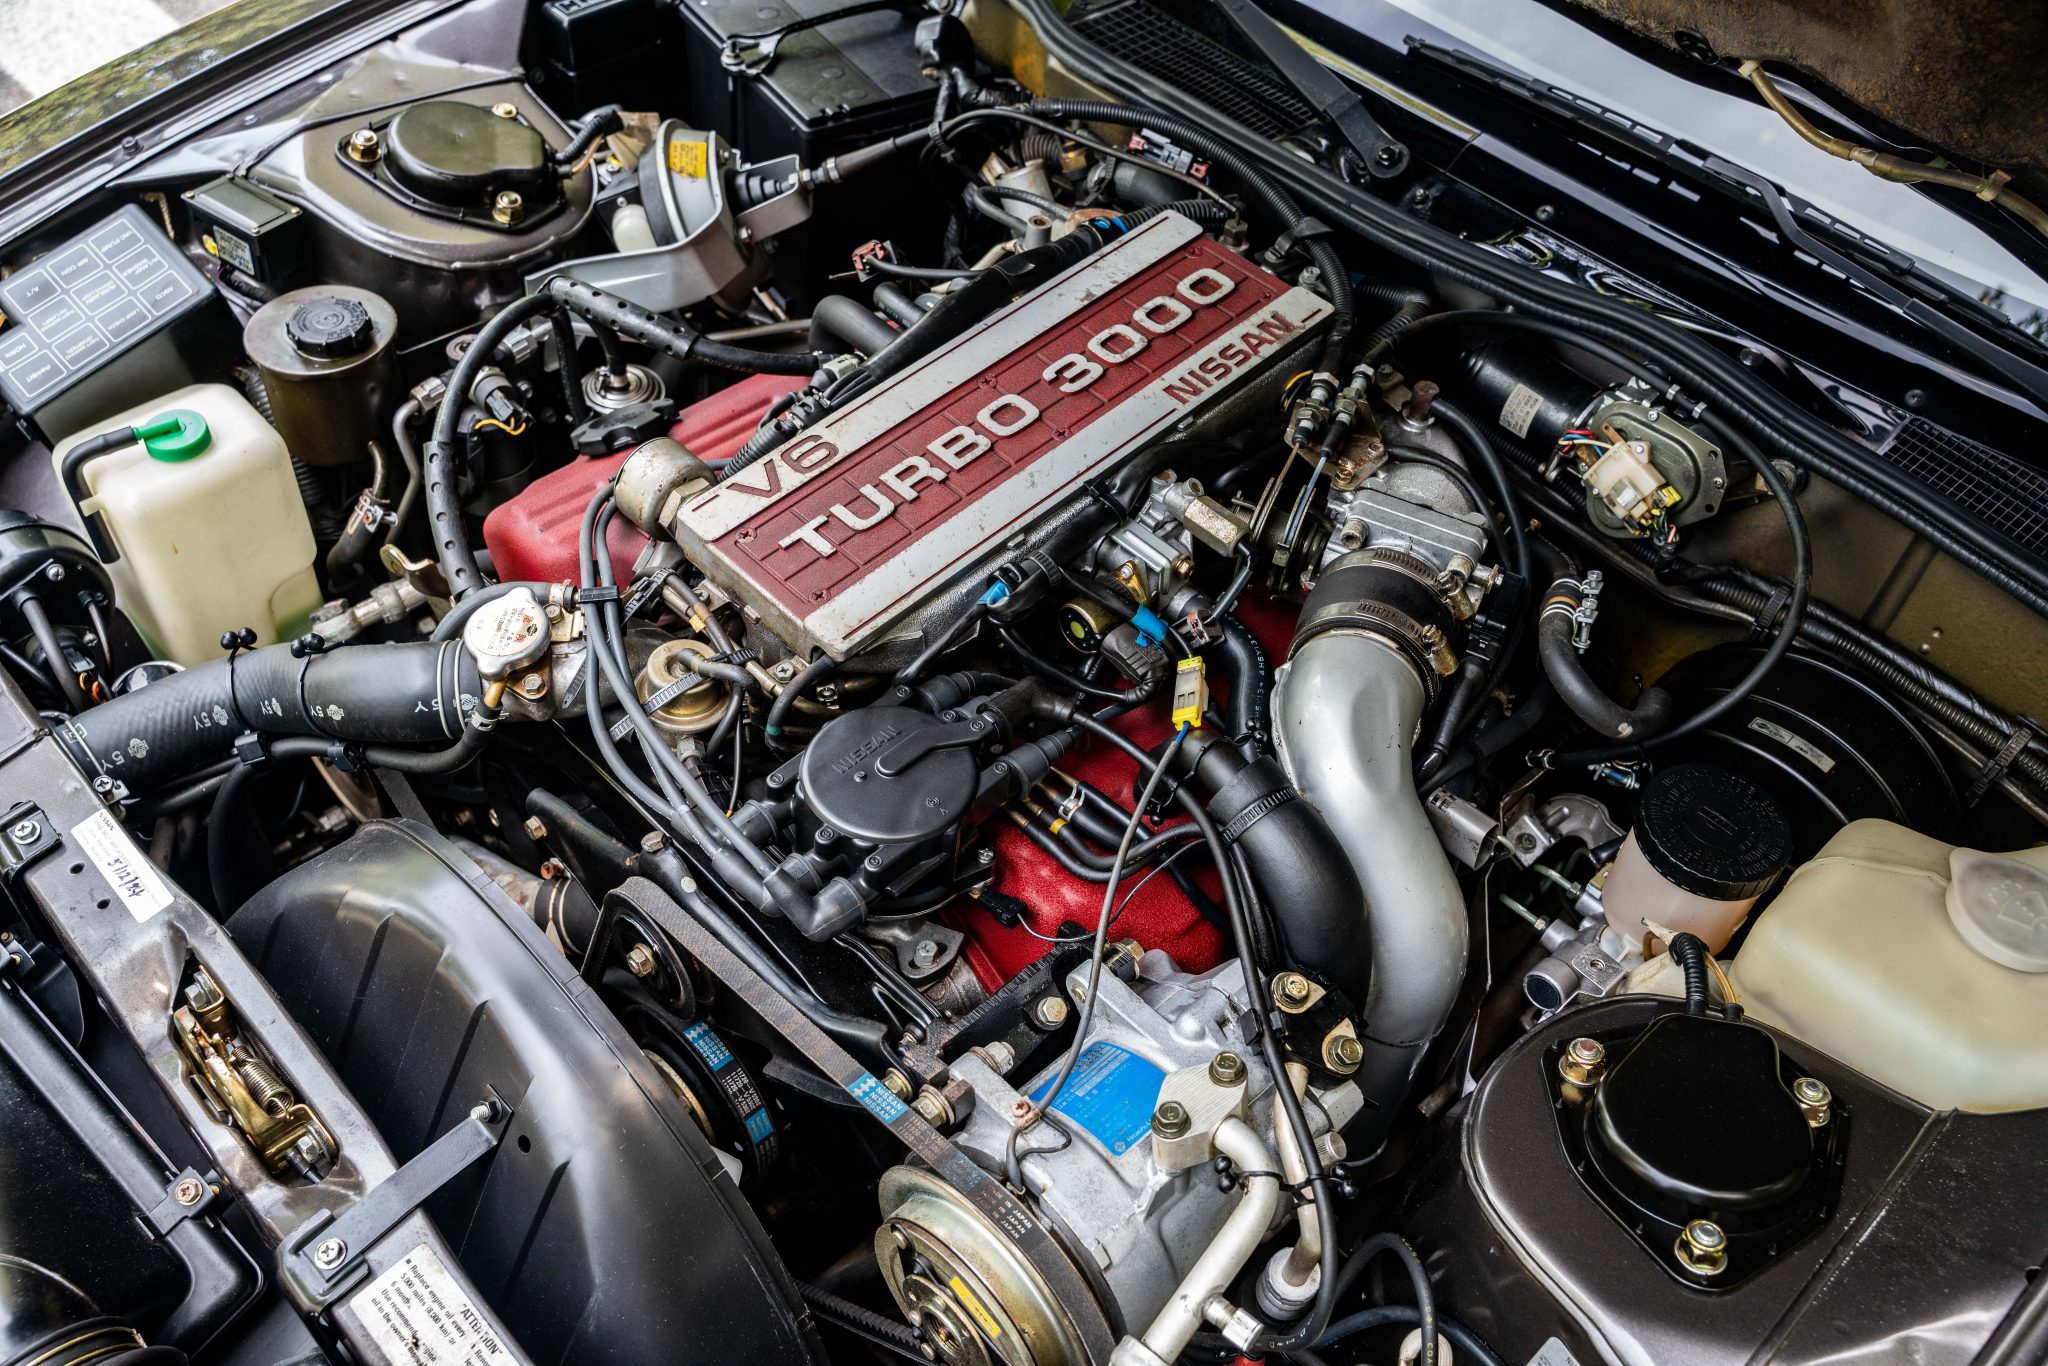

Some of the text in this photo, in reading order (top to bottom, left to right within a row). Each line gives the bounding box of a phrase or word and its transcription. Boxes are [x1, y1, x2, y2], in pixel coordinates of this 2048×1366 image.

[1162, 312, 1303, 406] NISSAN
[777, 266, 1236, 558] TURBO 3000
[727, 434, 839, 501] V6
[259, 699, 272, 714] 5Y
[309, 704, 323, 718] 5Y
[191, 710, 211, 730] 5Y
[834, 725, 898, 771] NISSAN
[99, 749, 125, 771] 5Y
[1006, 1214, 1025, 1233] JAPAN
[1012, 1208, 1032, 1228] JAPAN
[380, 1289, 392, 1301] Use
[409, 1265, 430, 1290] Replace
[449, 1319, 466, 1337] every
